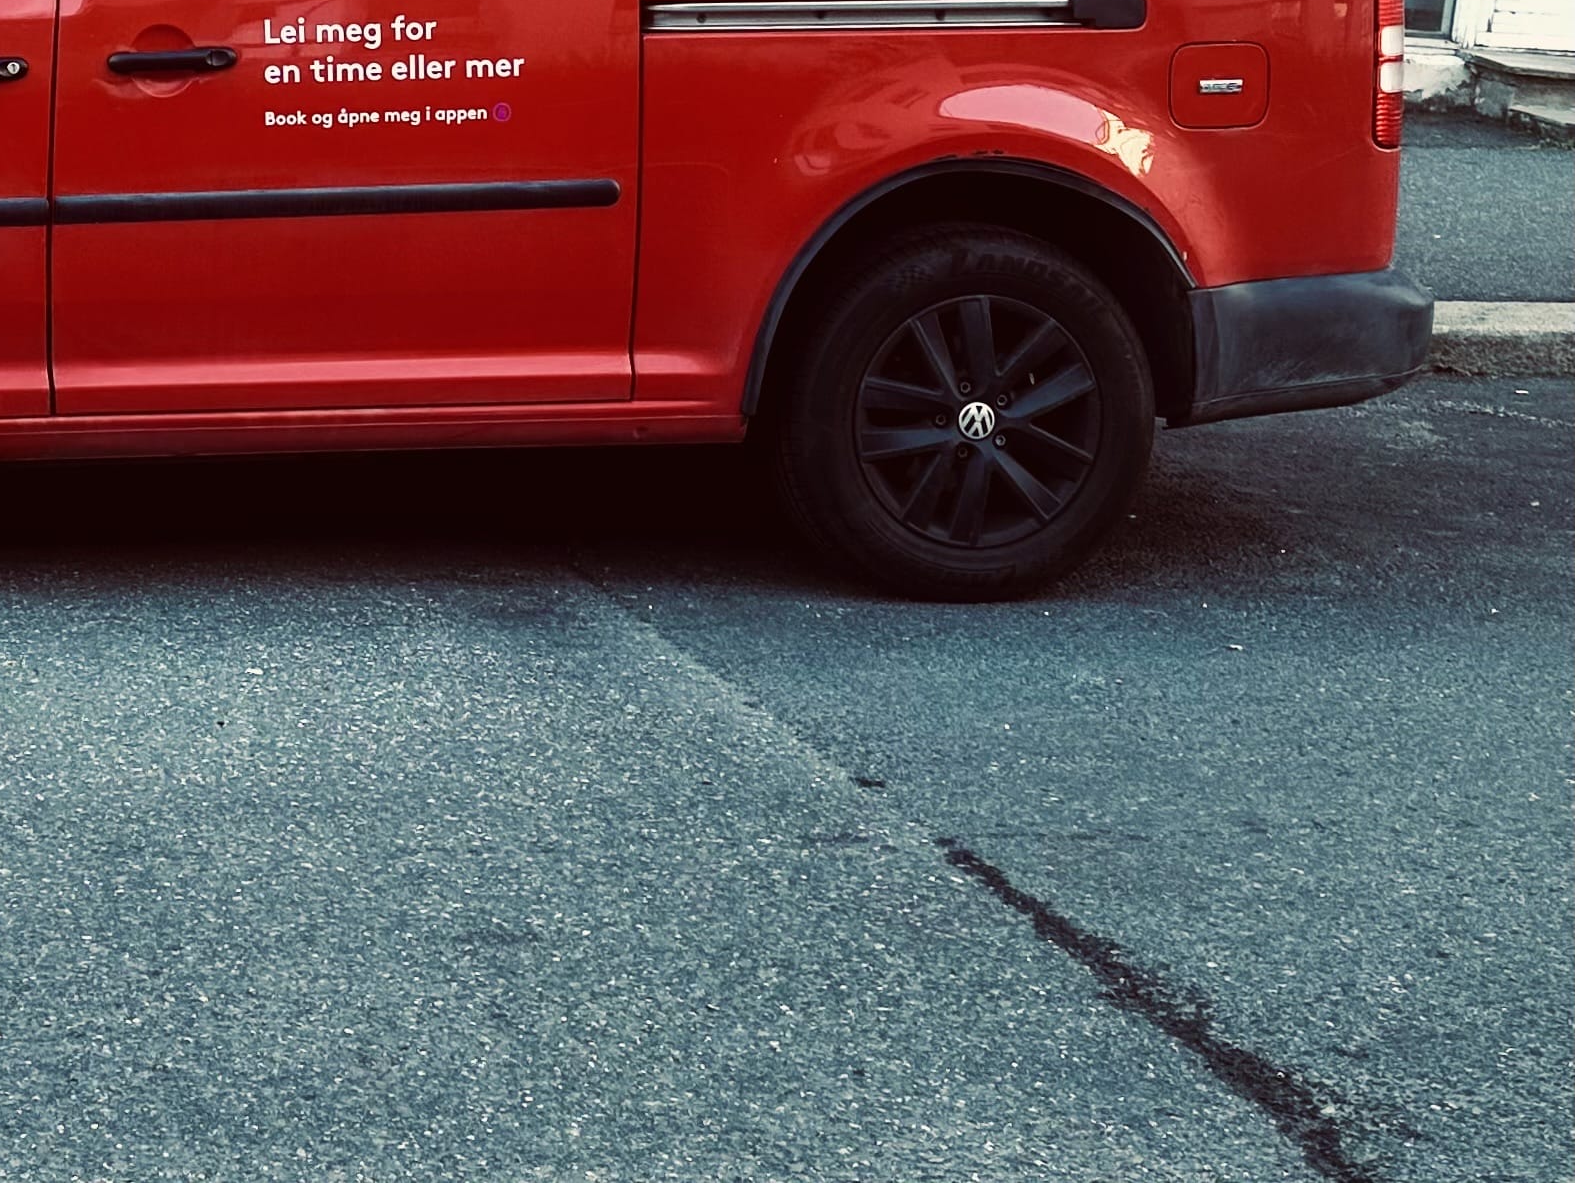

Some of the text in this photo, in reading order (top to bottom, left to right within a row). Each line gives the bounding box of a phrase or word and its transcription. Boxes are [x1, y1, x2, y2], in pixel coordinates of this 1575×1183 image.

[264, 15, 437, 49] Lei meg for
[264, 54, 525, 84] en time eller mer
[264, 106, 488, 129] Book og åpne meg i appen
